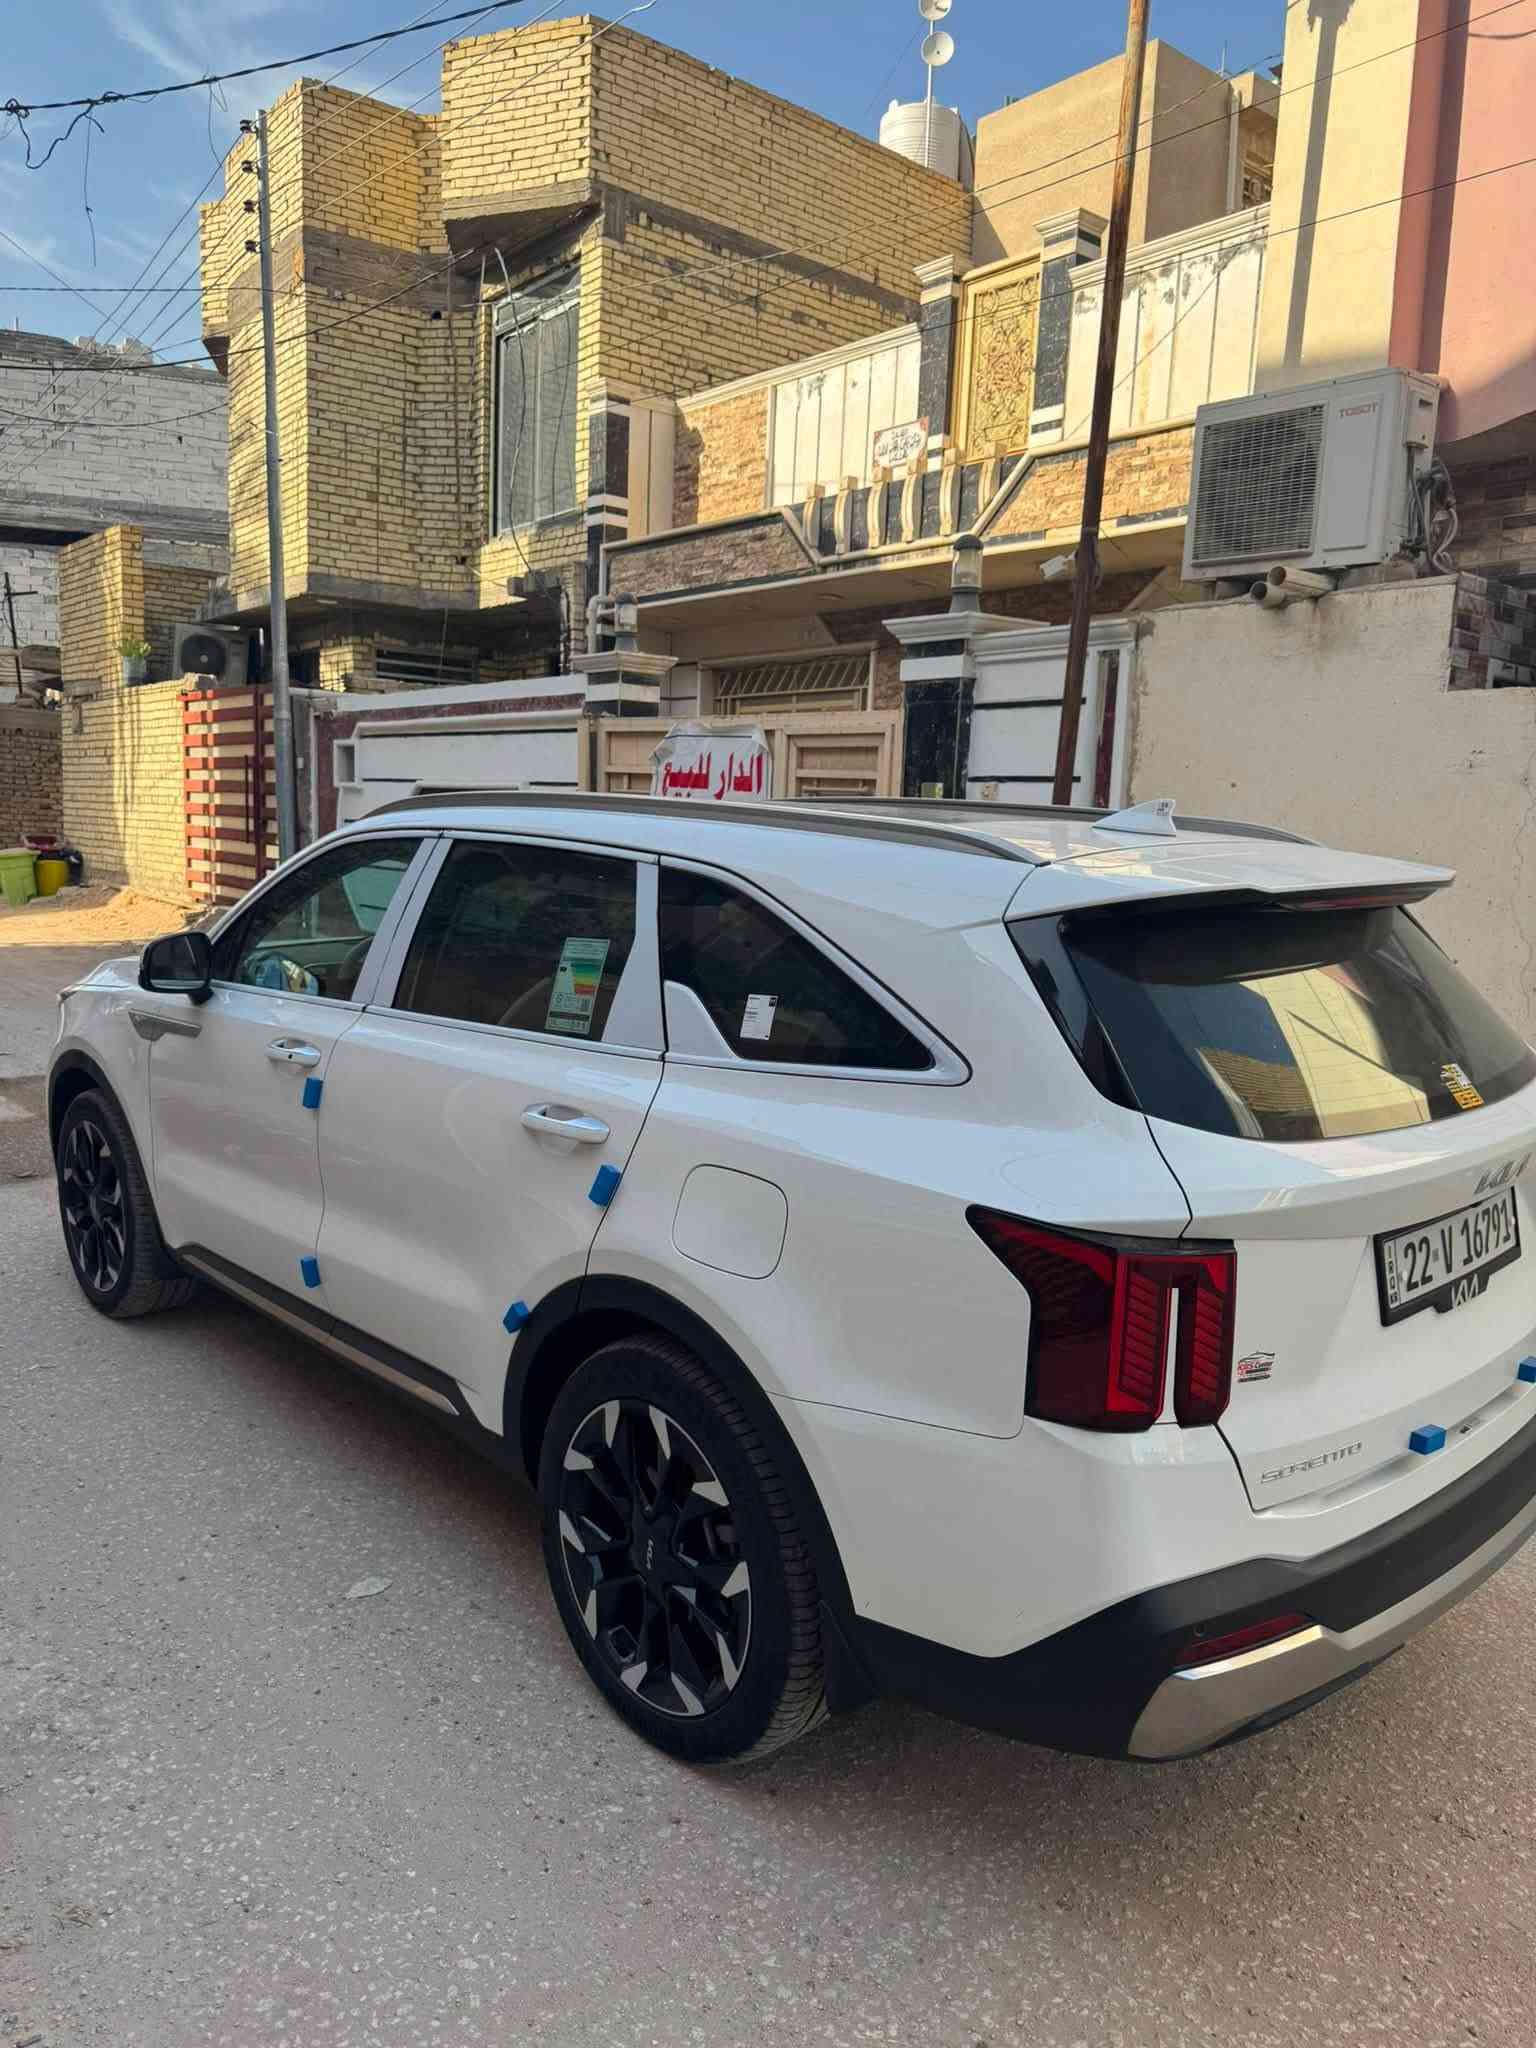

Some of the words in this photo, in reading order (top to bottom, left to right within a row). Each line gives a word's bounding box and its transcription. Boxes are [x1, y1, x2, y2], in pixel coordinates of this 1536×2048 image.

[662, 752, 712, 798] للبيع
[714, 752, 763, 801] الدار
[1404, 1236, 1433, 1292] 22
[1440, 1224, 1453, 1275] V
[1460, 1198, 1511, 1266] 16791
[1260, 1441, 1361, 1484] SORENTO
